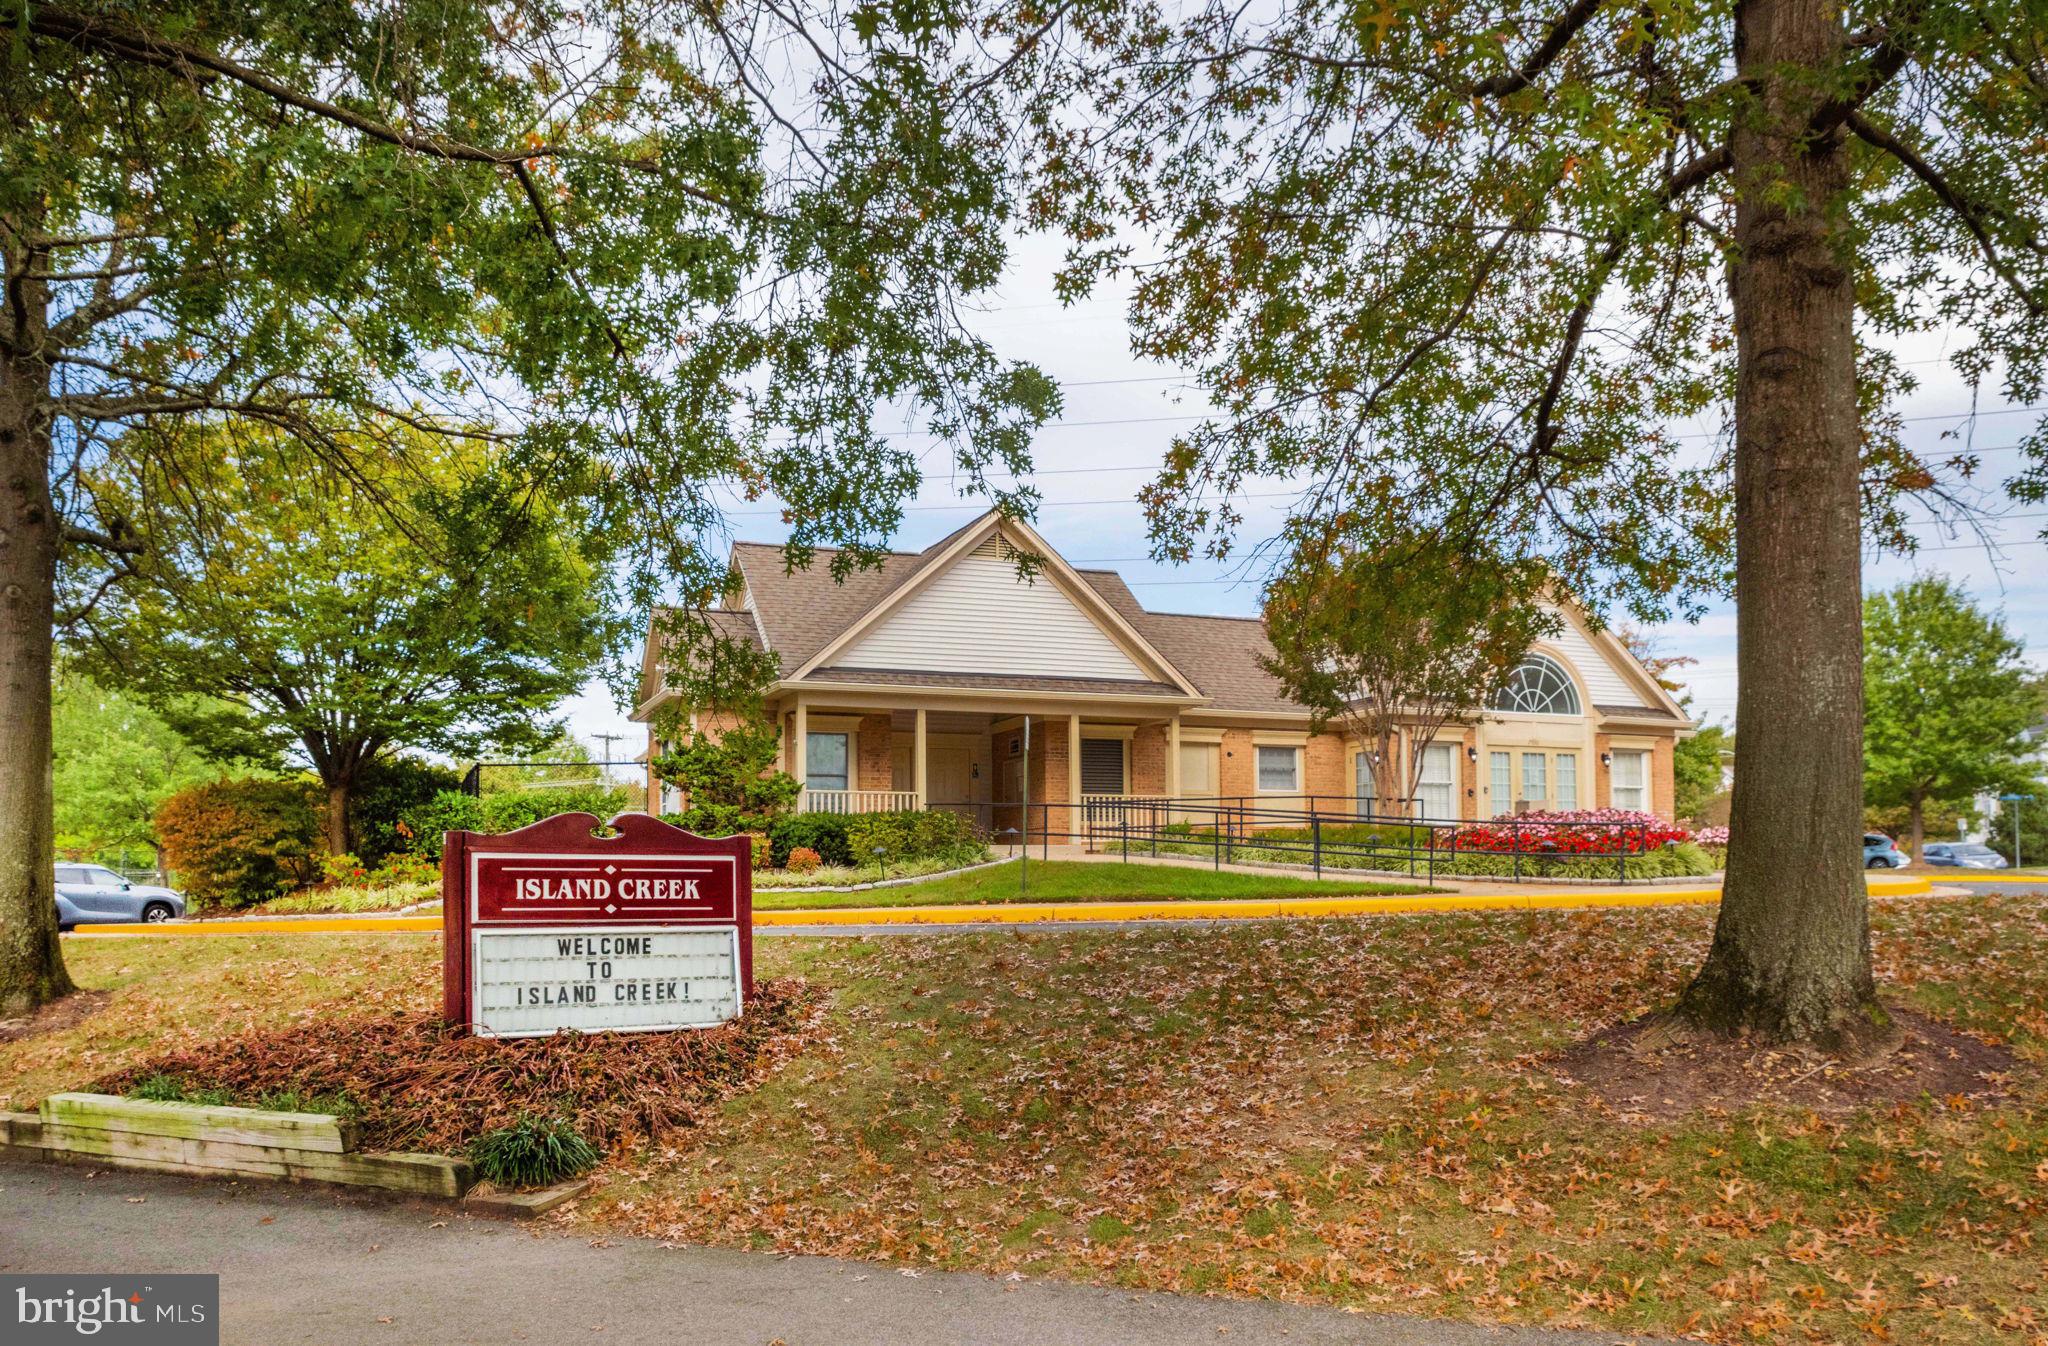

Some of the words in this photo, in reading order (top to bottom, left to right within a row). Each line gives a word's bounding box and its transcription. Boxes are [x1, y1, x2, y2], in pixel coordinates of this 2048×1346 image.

[515, 878, 611, 900] ISLAND
[618, 878, 700, 900] CREEK
[558, 937, 652, 956] WELCOME
[586, 961, 612, 979] TO
[517, 985, 596, 1005] ISLAND
[615, 982, 689, 1001] CREEK!
